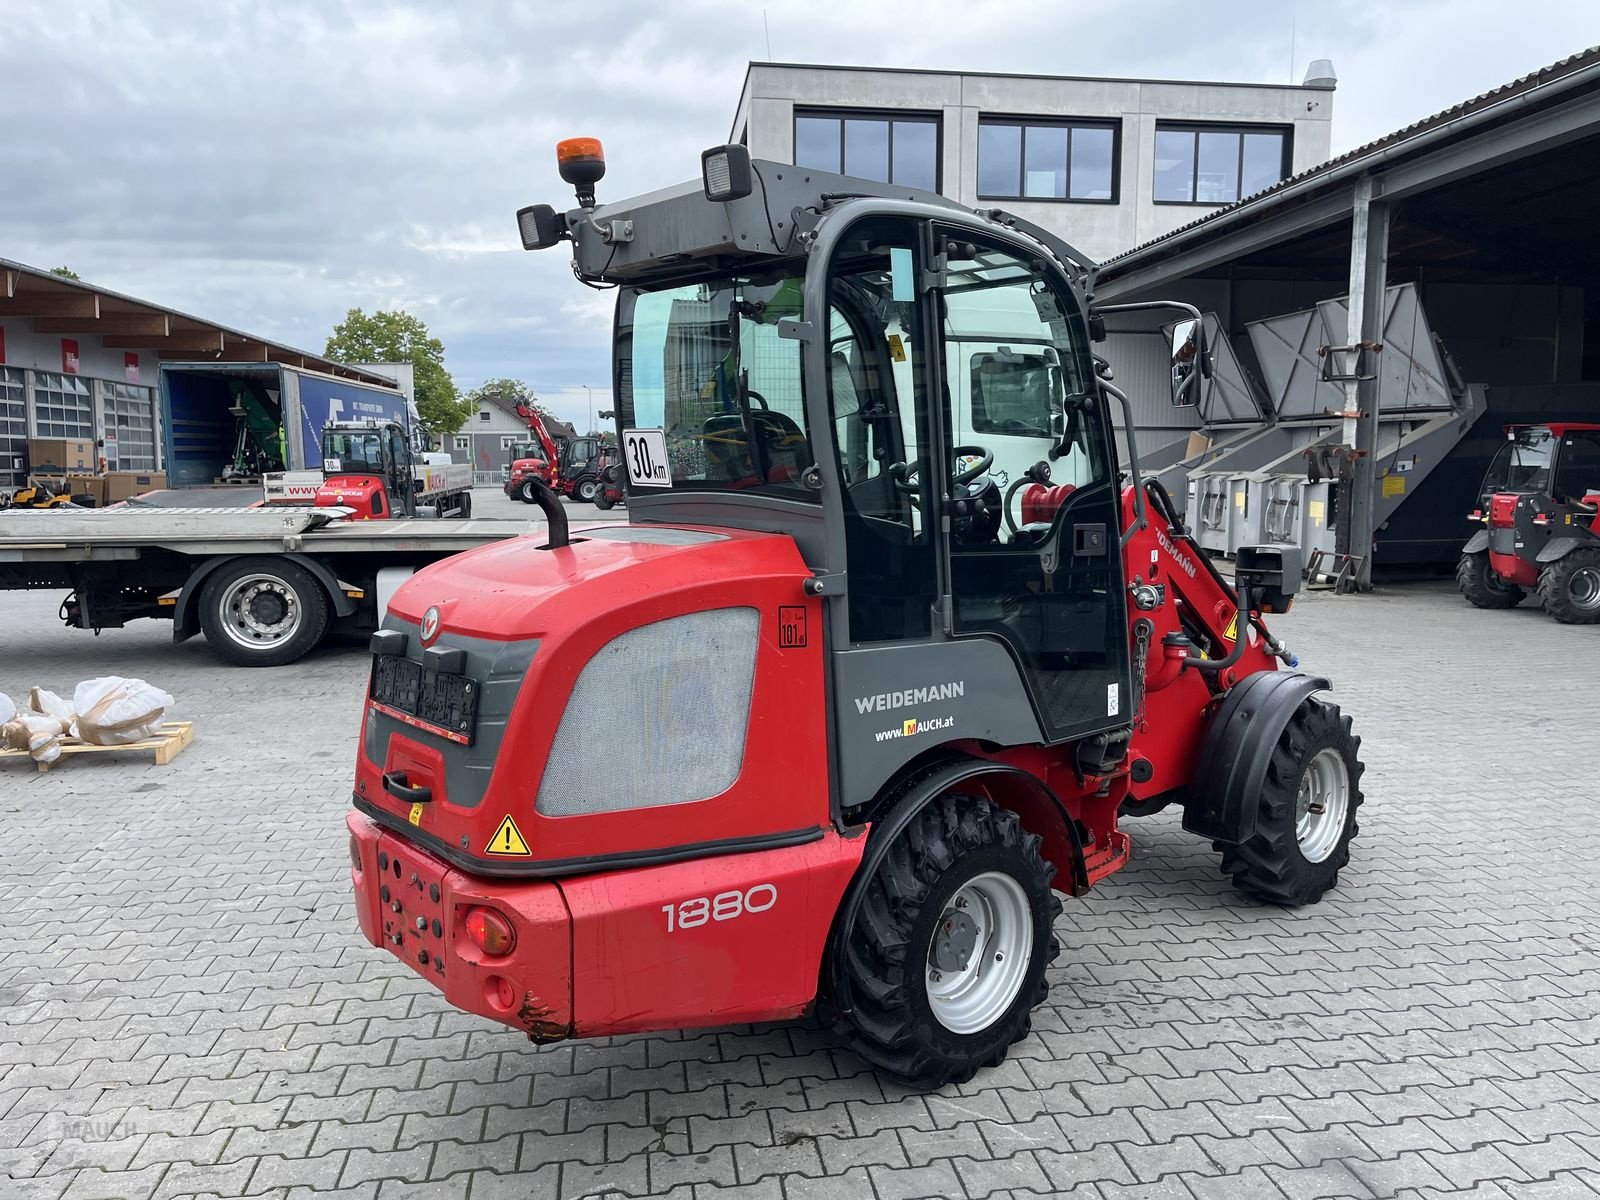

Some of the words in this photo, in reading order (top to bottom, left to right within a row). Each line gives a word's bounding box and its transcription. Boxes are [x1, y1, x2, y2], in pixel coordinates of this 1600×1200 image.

[326, 460, 334, 470] 30
[629, 437, 652, 478] 30
[652, 460, 666, 479] km
[782, 624, 798, 645] 101
[855, 681, 965, 714] WEIDEMANN
[875, 716, 954, 742] www.MAUCH.at
[662, 883, 777, 932] 1880
